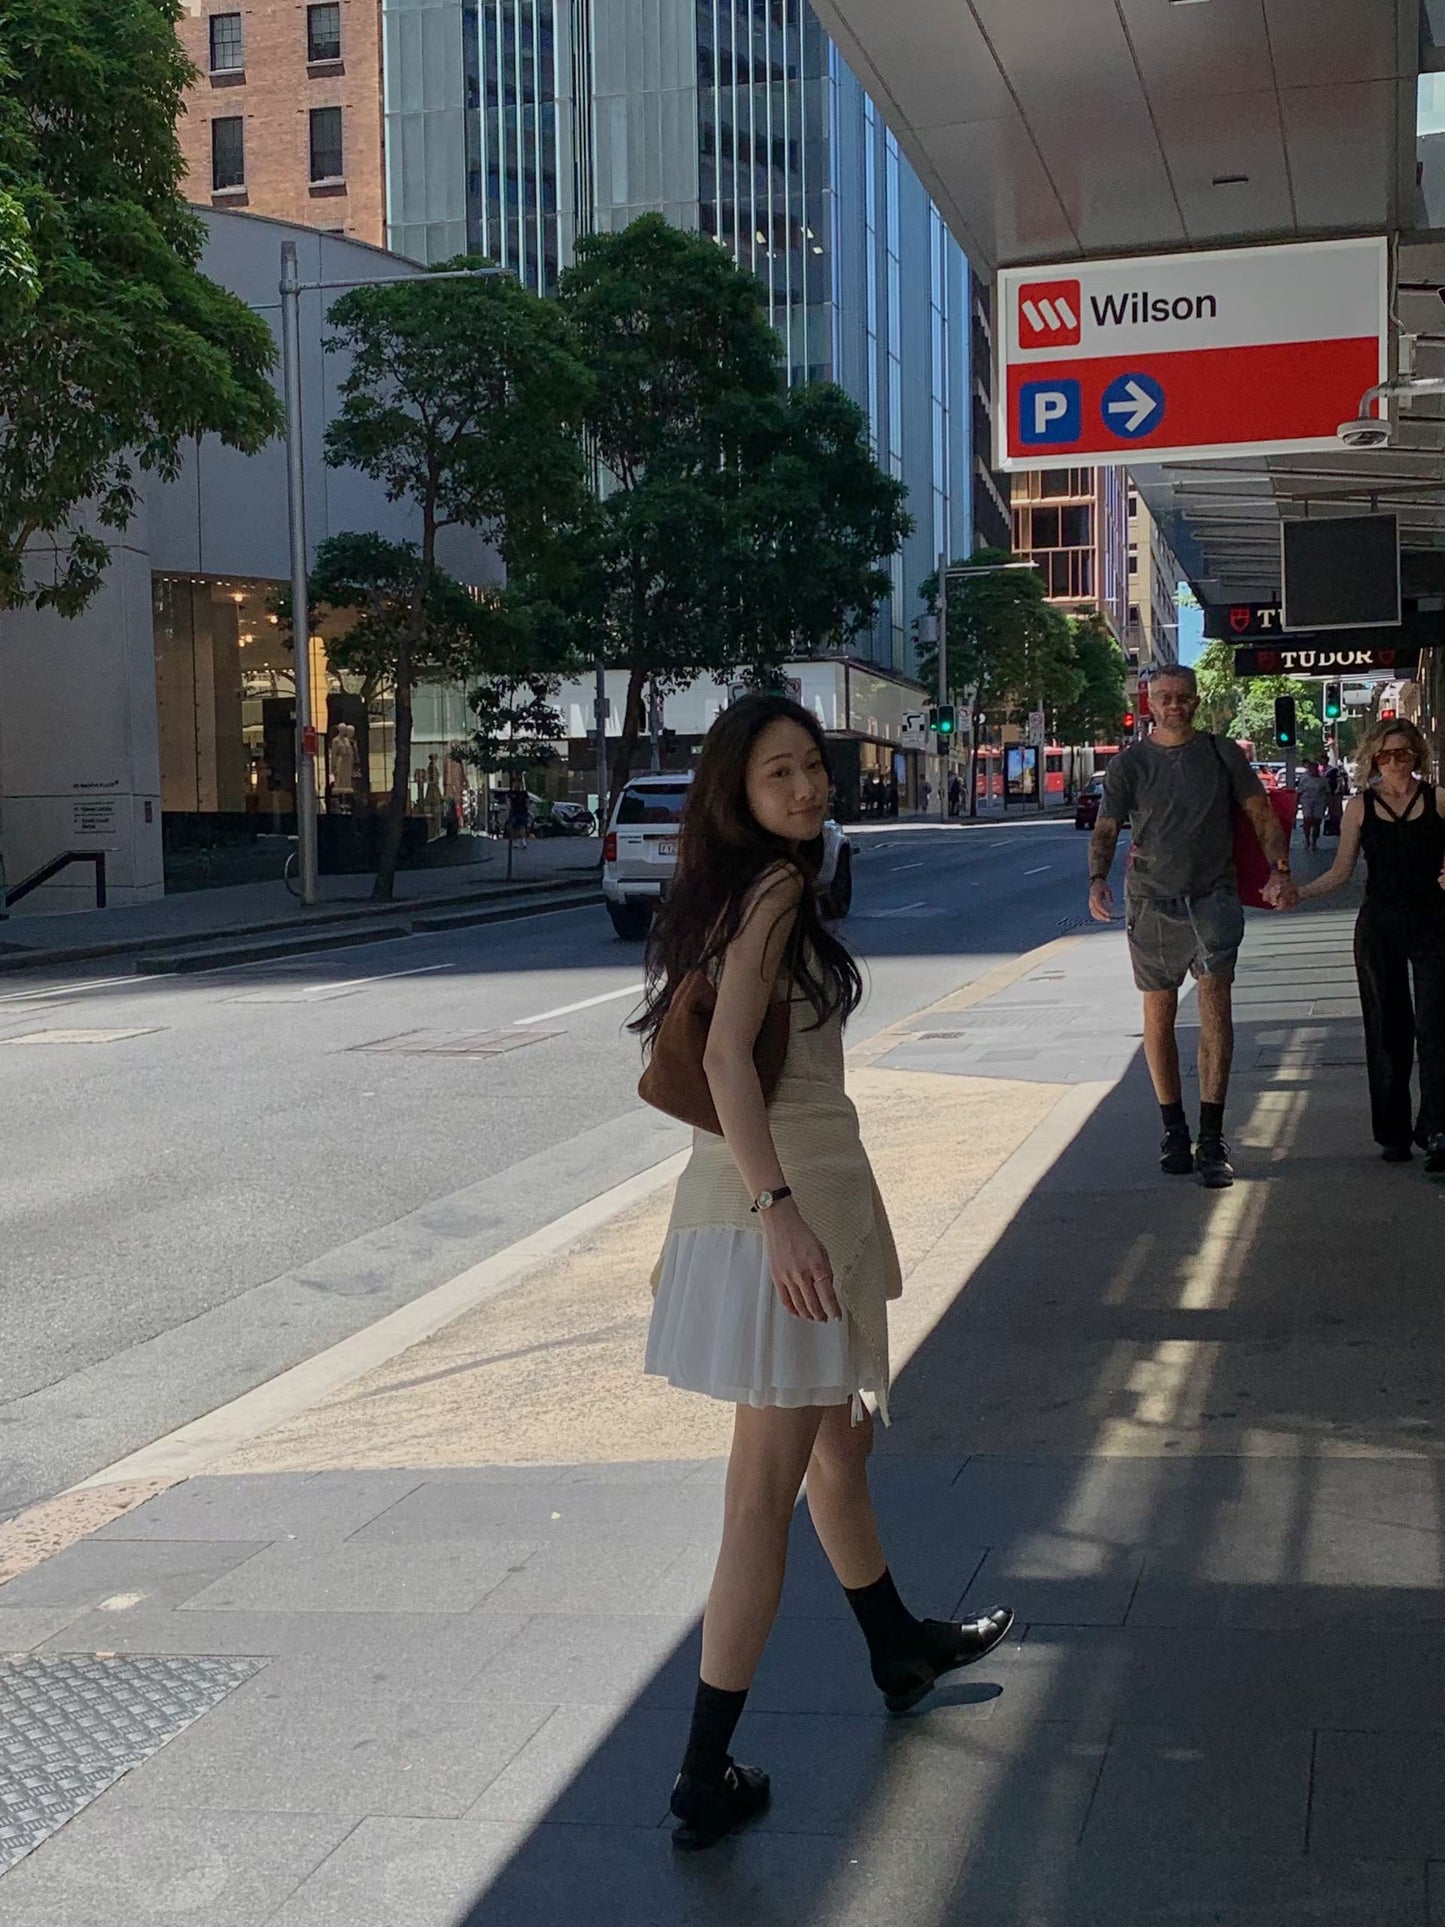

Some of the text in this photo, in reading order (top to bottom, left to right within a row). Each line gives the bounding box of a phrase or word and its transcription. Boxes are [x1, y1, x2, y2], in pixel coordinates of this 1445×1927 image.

[1090, 291, 1217, 326] Wilson
[1035, 391, 1068, 434] P
[1281, 650, 1374, 668] TUDOR
